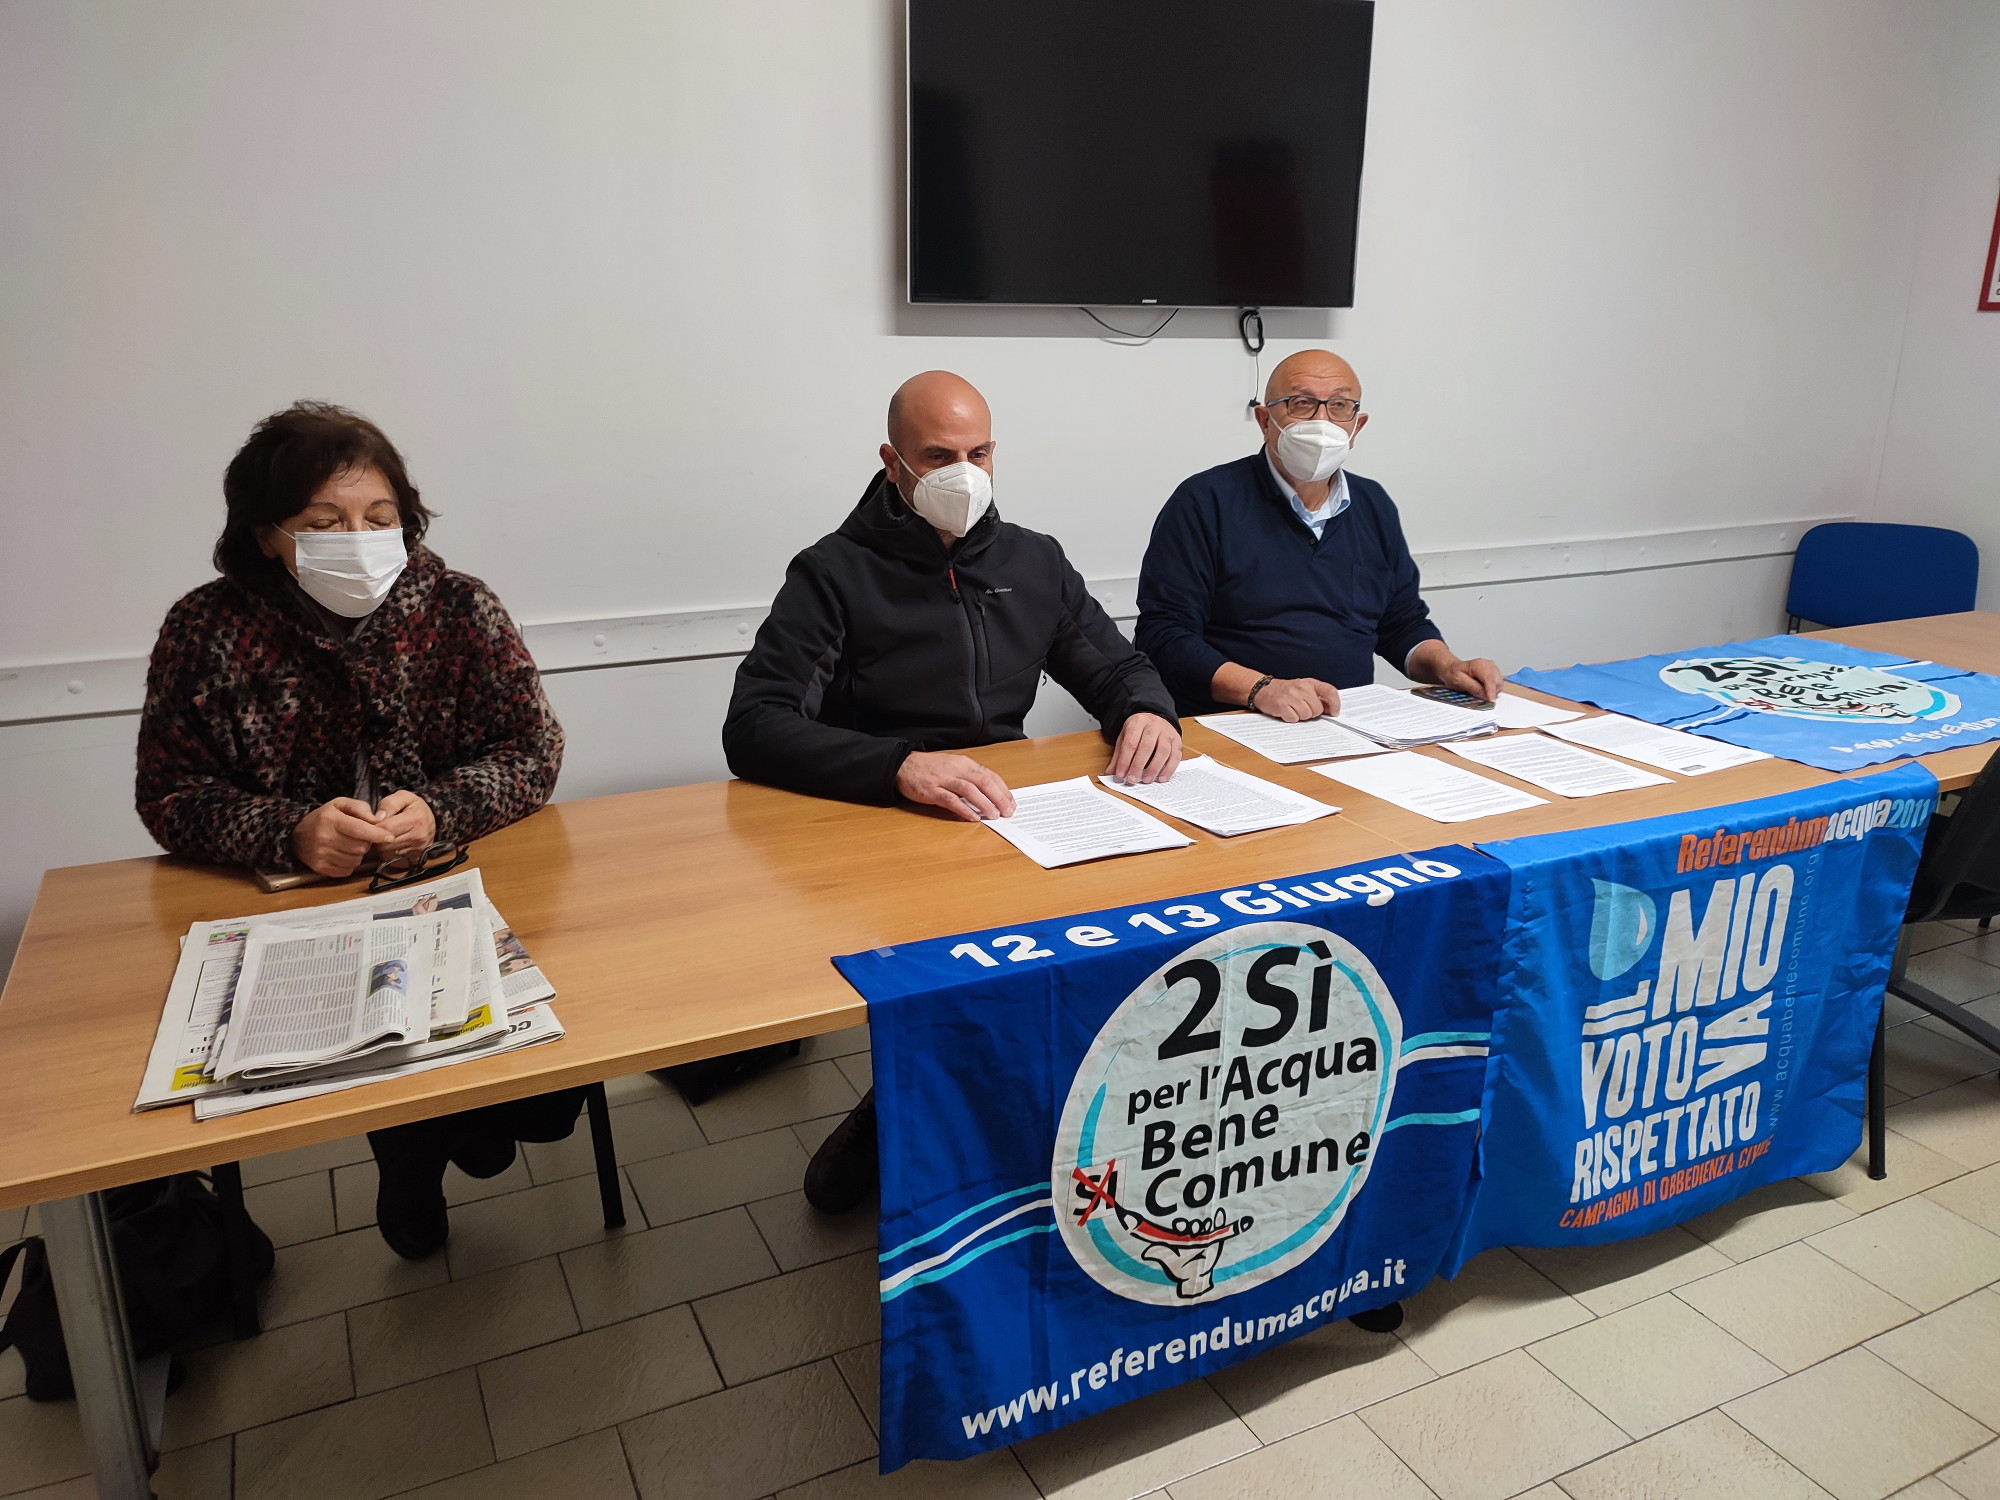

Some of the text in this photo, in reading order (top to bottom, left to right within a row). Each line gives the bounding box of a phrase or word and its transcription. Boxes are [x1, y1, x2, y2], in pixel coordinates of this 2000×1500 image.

[949, 857, 1463, 969] 12 e 13 Giugno
[1581, 863, 1796, 1036] IL MIO
[1126, 1080, 1191, 1125] per
[1581, 990, 1773, 1130] VOTO VA
[1139, 1102, 1280, 1171] Bene
[1143, 1130, 1371, 1218] Comune
[1558, 1186, 1639, 1229] CAMPAGNA
[1642, 1180, 1657, 1206] DI
[1660, 1153, 1734, 1201] OBBEDIENZA
[1570, 1080, 1762, 1204] RISPETTATO
[960, 1258, 1407, 1440] www.referendumacqua.it
